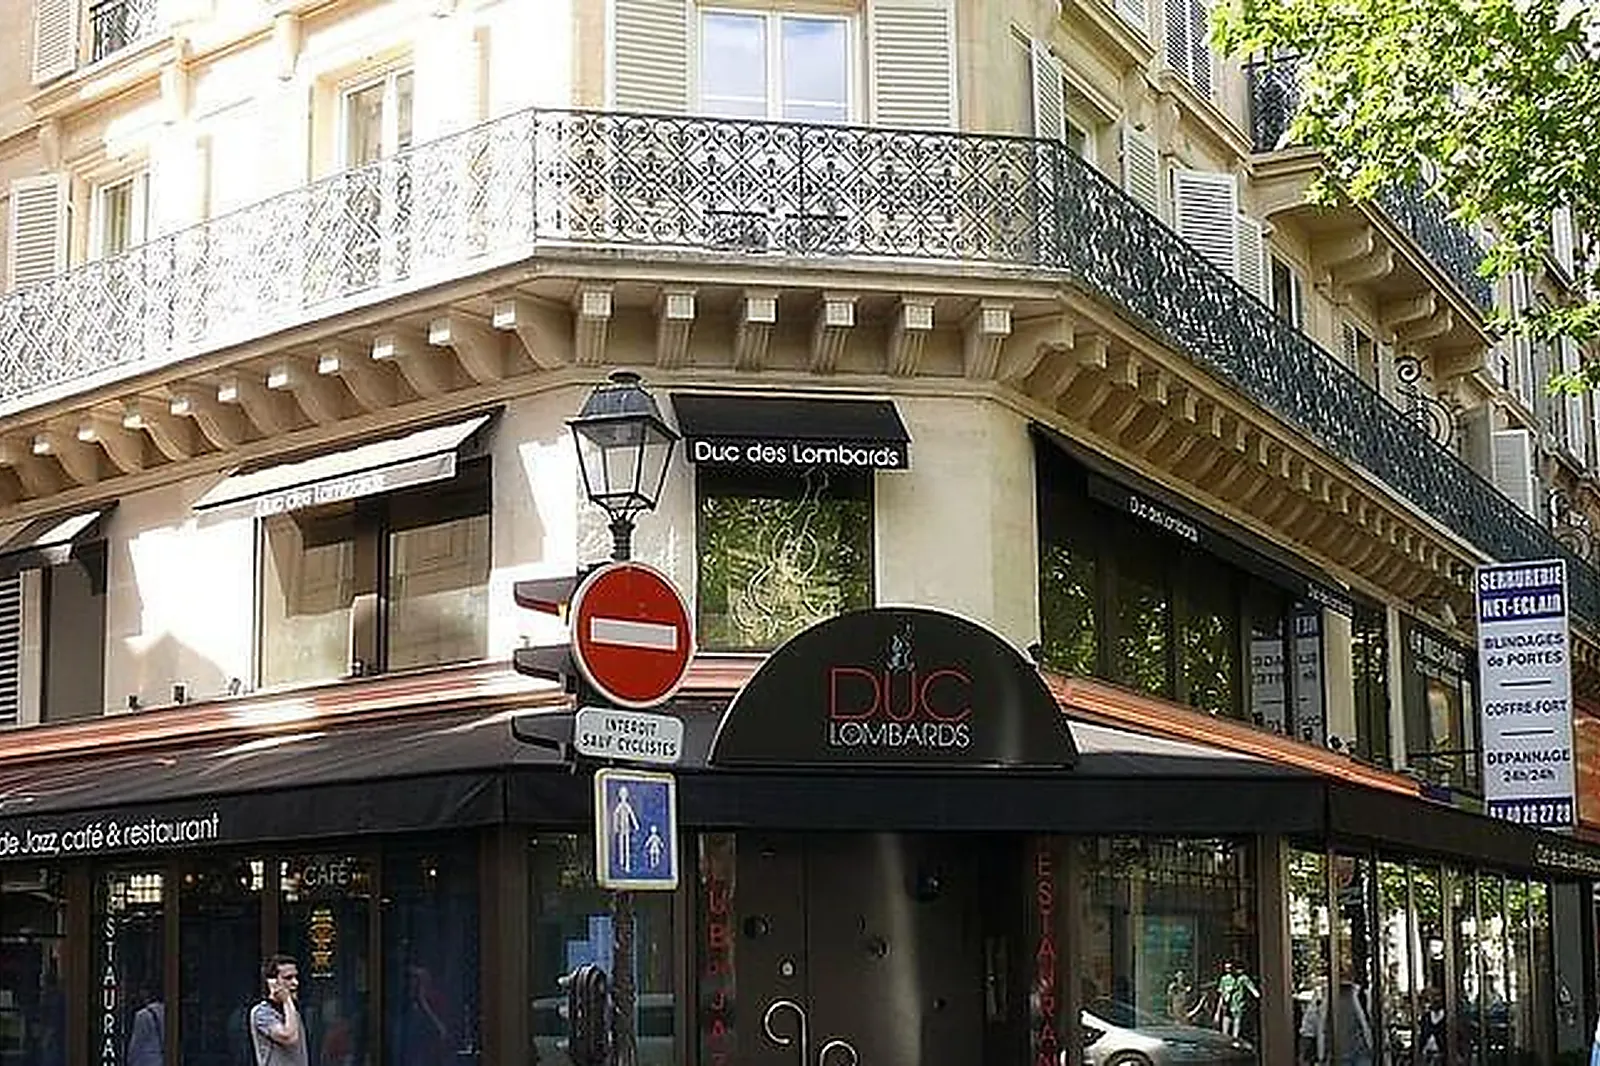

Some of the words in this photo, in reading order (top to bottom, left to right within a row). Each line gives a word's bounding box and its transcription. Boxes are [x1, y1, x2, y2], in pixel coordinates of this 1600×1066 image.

[695, 441, 739, 461] Duc
[747, 443, 786, 462] des
[793, 444, 899, 466] Lombards
[1480, 566, 1562, 590] SERRURERIE
[1484, 633, 1564, 649] BLINDAGES
[1487, 656, 1504, 667] de
[1507, 651, 1562, 666] PORTES
[831, 667, 973, 721] DUC
[605, 717, 657, 736] INTERDIT
[829, 722, 970, 746] LOMBARDS
[582, 732, 612, 749] SAUF
[618, 737, 677, 757] CYCLISTES
[1487, 749, 1571, 765] DEPANNAGE
[1540, 804, 1554, 823] 27
[61, 822, 104, 851] café
[106, 821, 121, 847] &
[123, 812, 220, 846] restaurant
